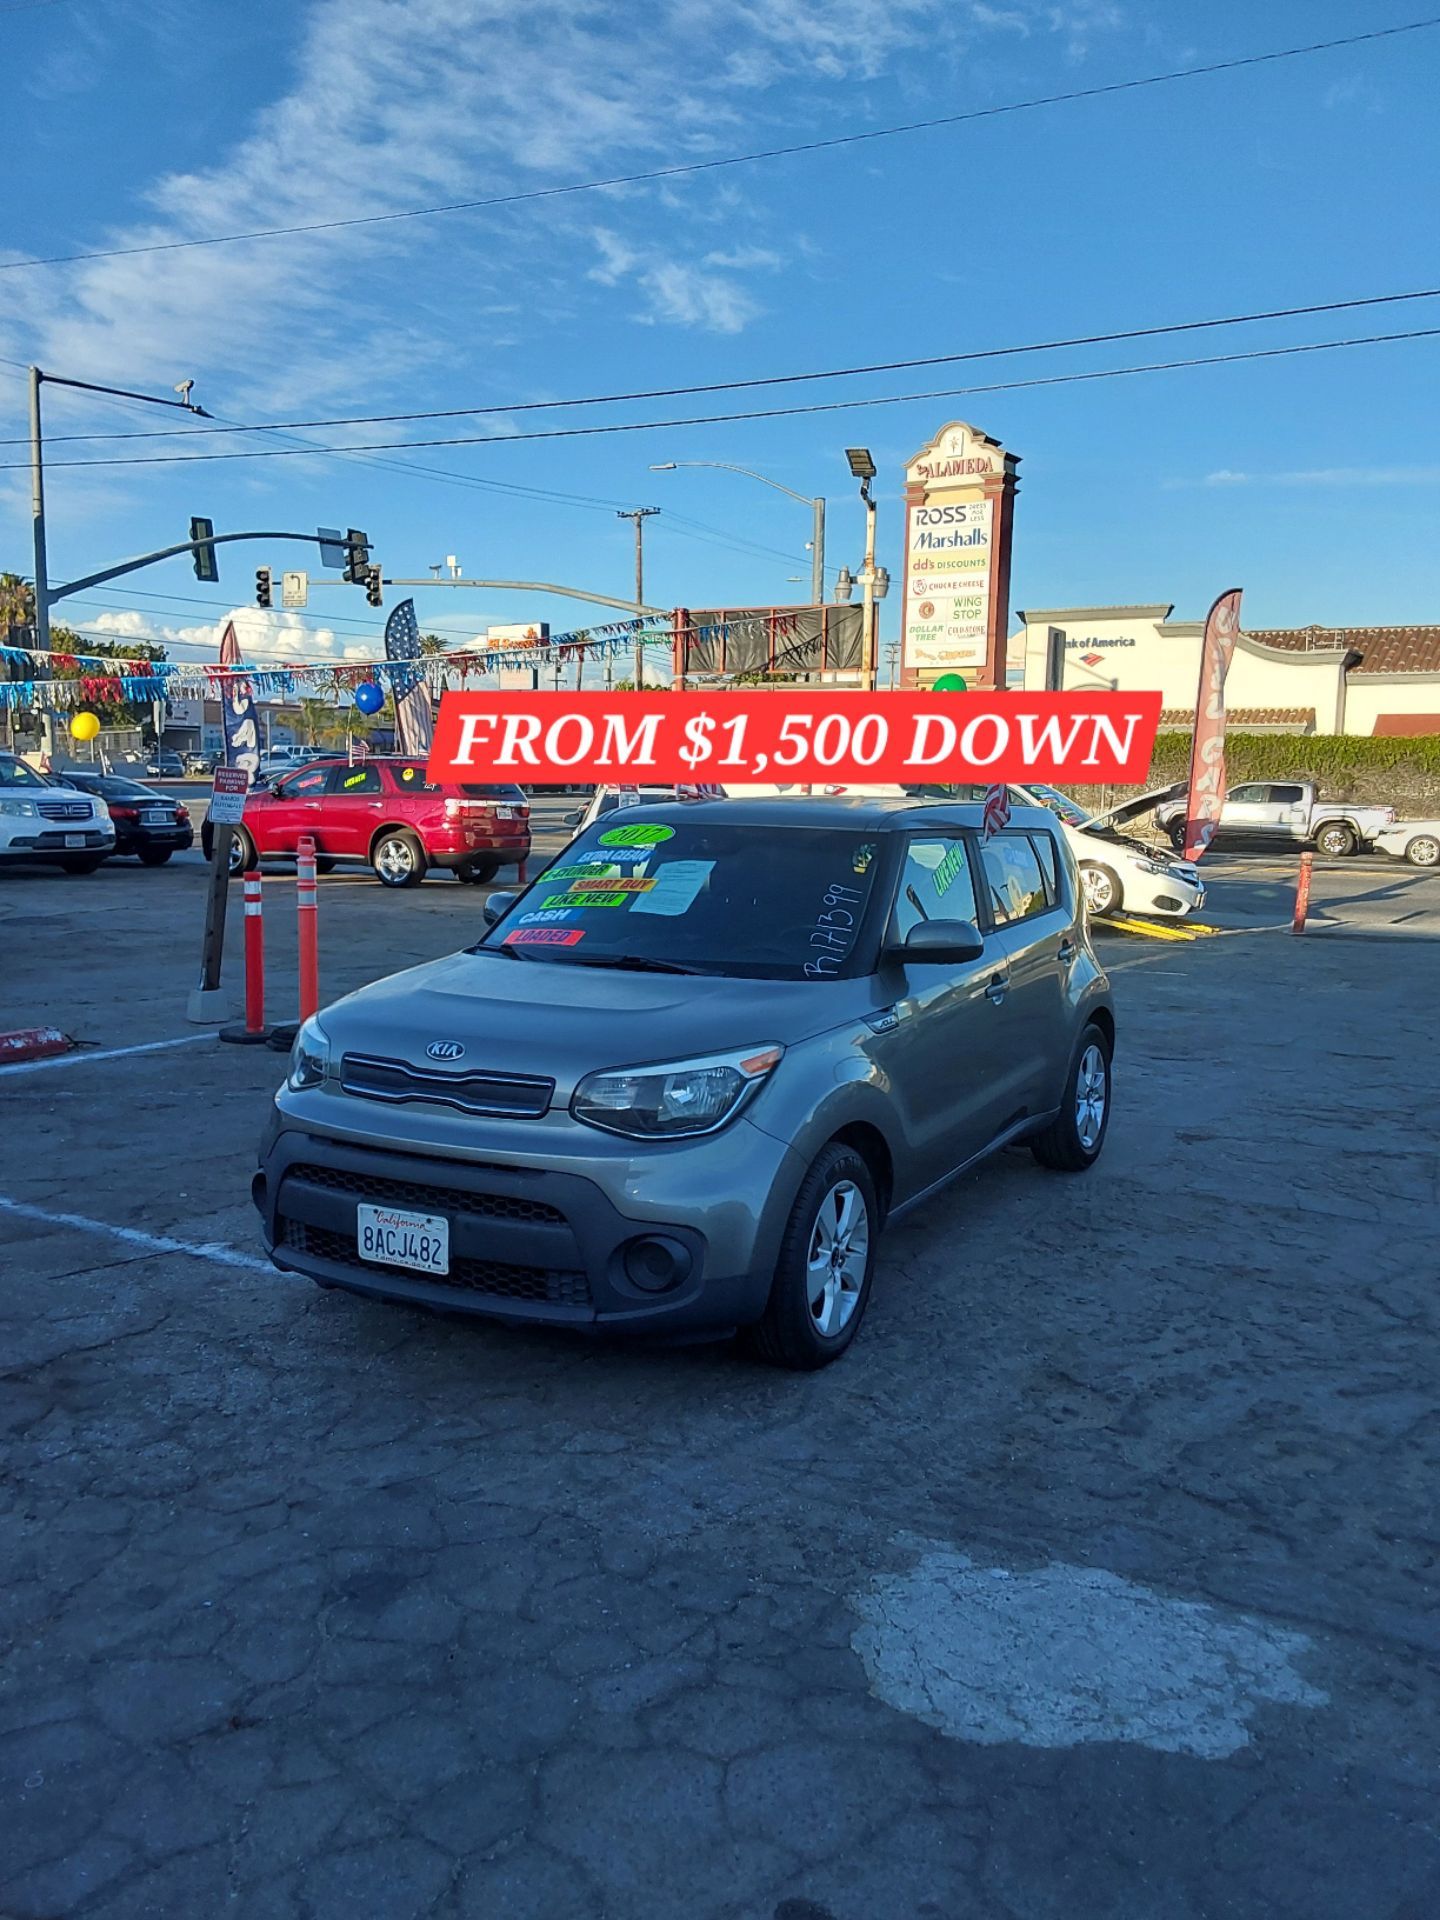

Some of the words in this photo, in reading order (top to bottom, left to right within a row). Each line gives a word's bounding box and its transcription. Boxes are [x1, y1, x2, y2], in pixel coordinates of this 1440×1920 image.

[926, 456, 994, 478] ALAMEDA
[916, 506, 966, 526] ROSS
[913, 528, 988, 549] Marshalls
[913, 558, 935, 570] dd's
[937, 558, 986, 569] DISCOUNTS
[953, 597, 982, 607] WING
[953, 609, 982, 620] STOP
[1079, 637, 1091, 648] of
[1091, 635, 1136, 648] America
[604, 827, 663, 842] 2017
[573, 879, 618, 891] SMART
[620, 879, 652, 890] BUY
[547, 893, 580, 905] LIKE
[583, 892, 619, 904] NEW
[518, 909, 572, 925] CASH
[515, 929, 573, 942] LOADED
[430, 1043, 458, 1057] KIA
[376, 1210, 431, 1232] California
[364, 1226, 442, 1266] 8ACJ482
